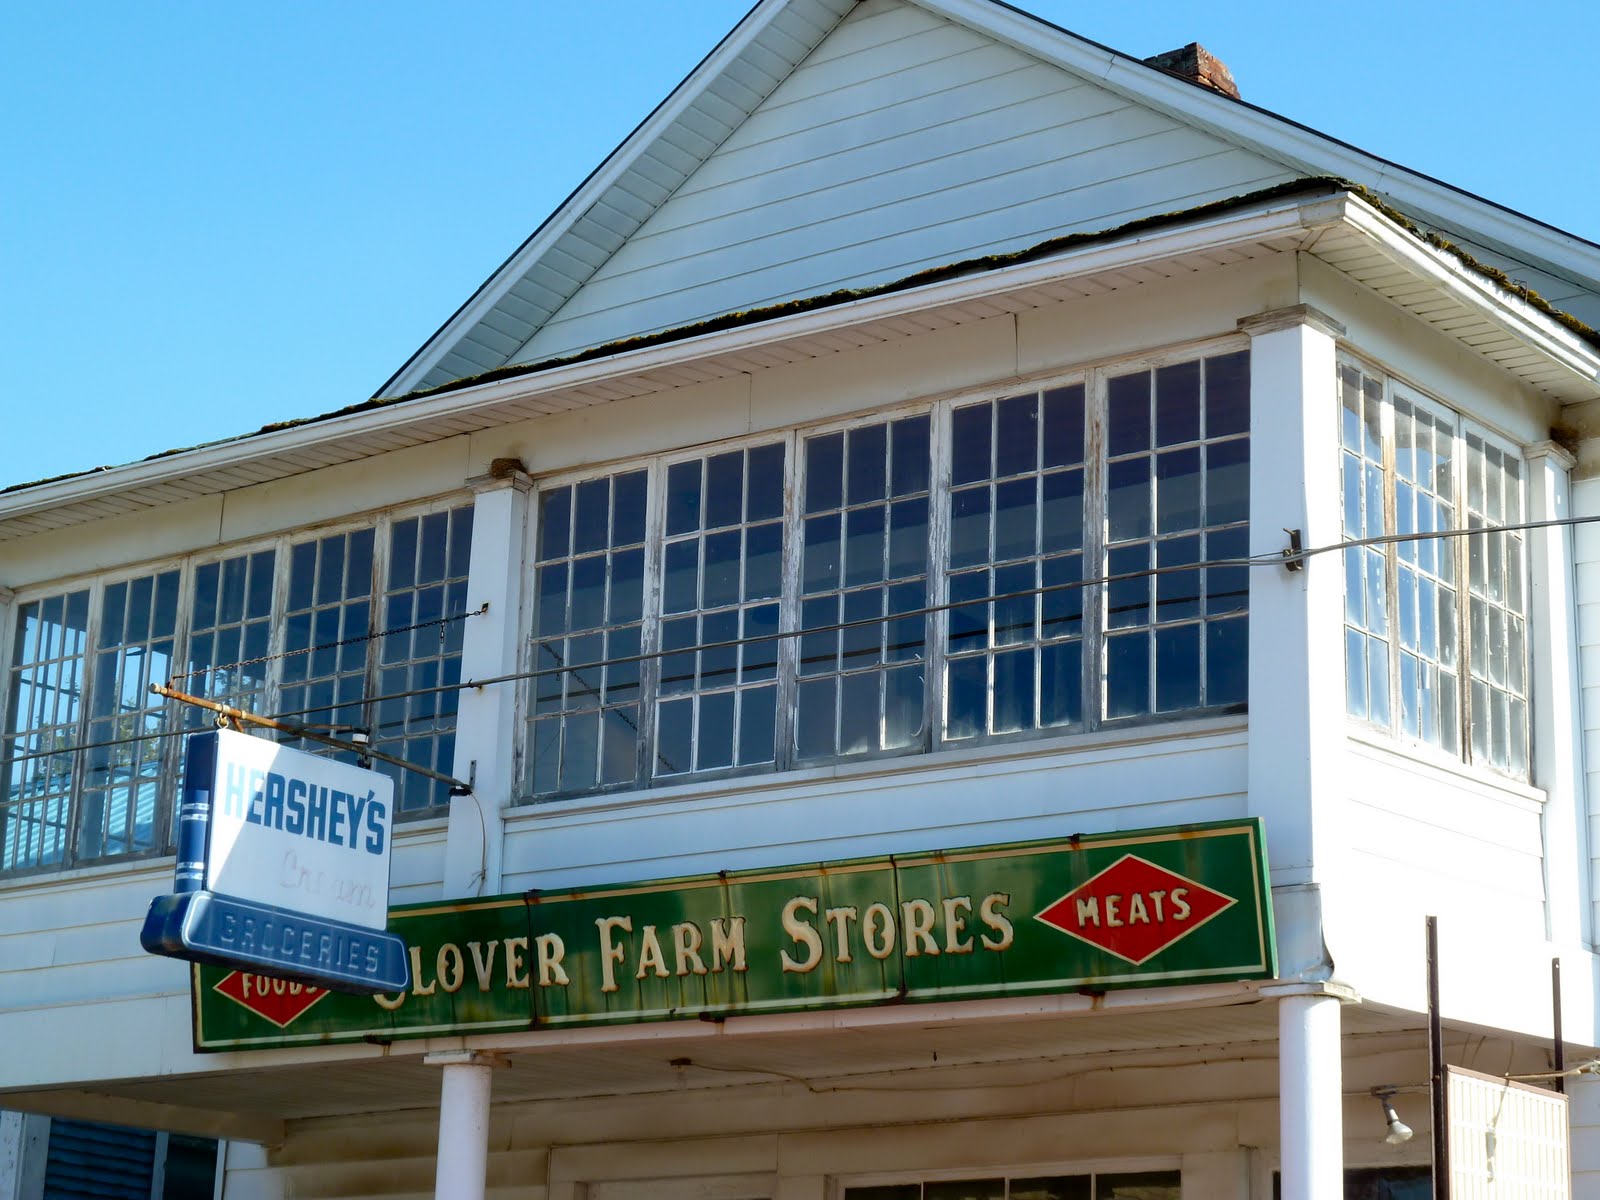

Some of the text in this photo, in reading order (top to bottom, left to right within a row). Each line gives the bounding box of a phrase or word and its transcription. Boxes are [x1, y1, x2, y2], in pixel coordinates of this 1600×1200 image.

[222, 761, 386, 856] HERSHEY'S
[219, 912, 380, 973] GROCERIES
[1076, 888, 1192, 928] MEATS
[373, 893, 1014, 1011] LOVER FARM STORES
